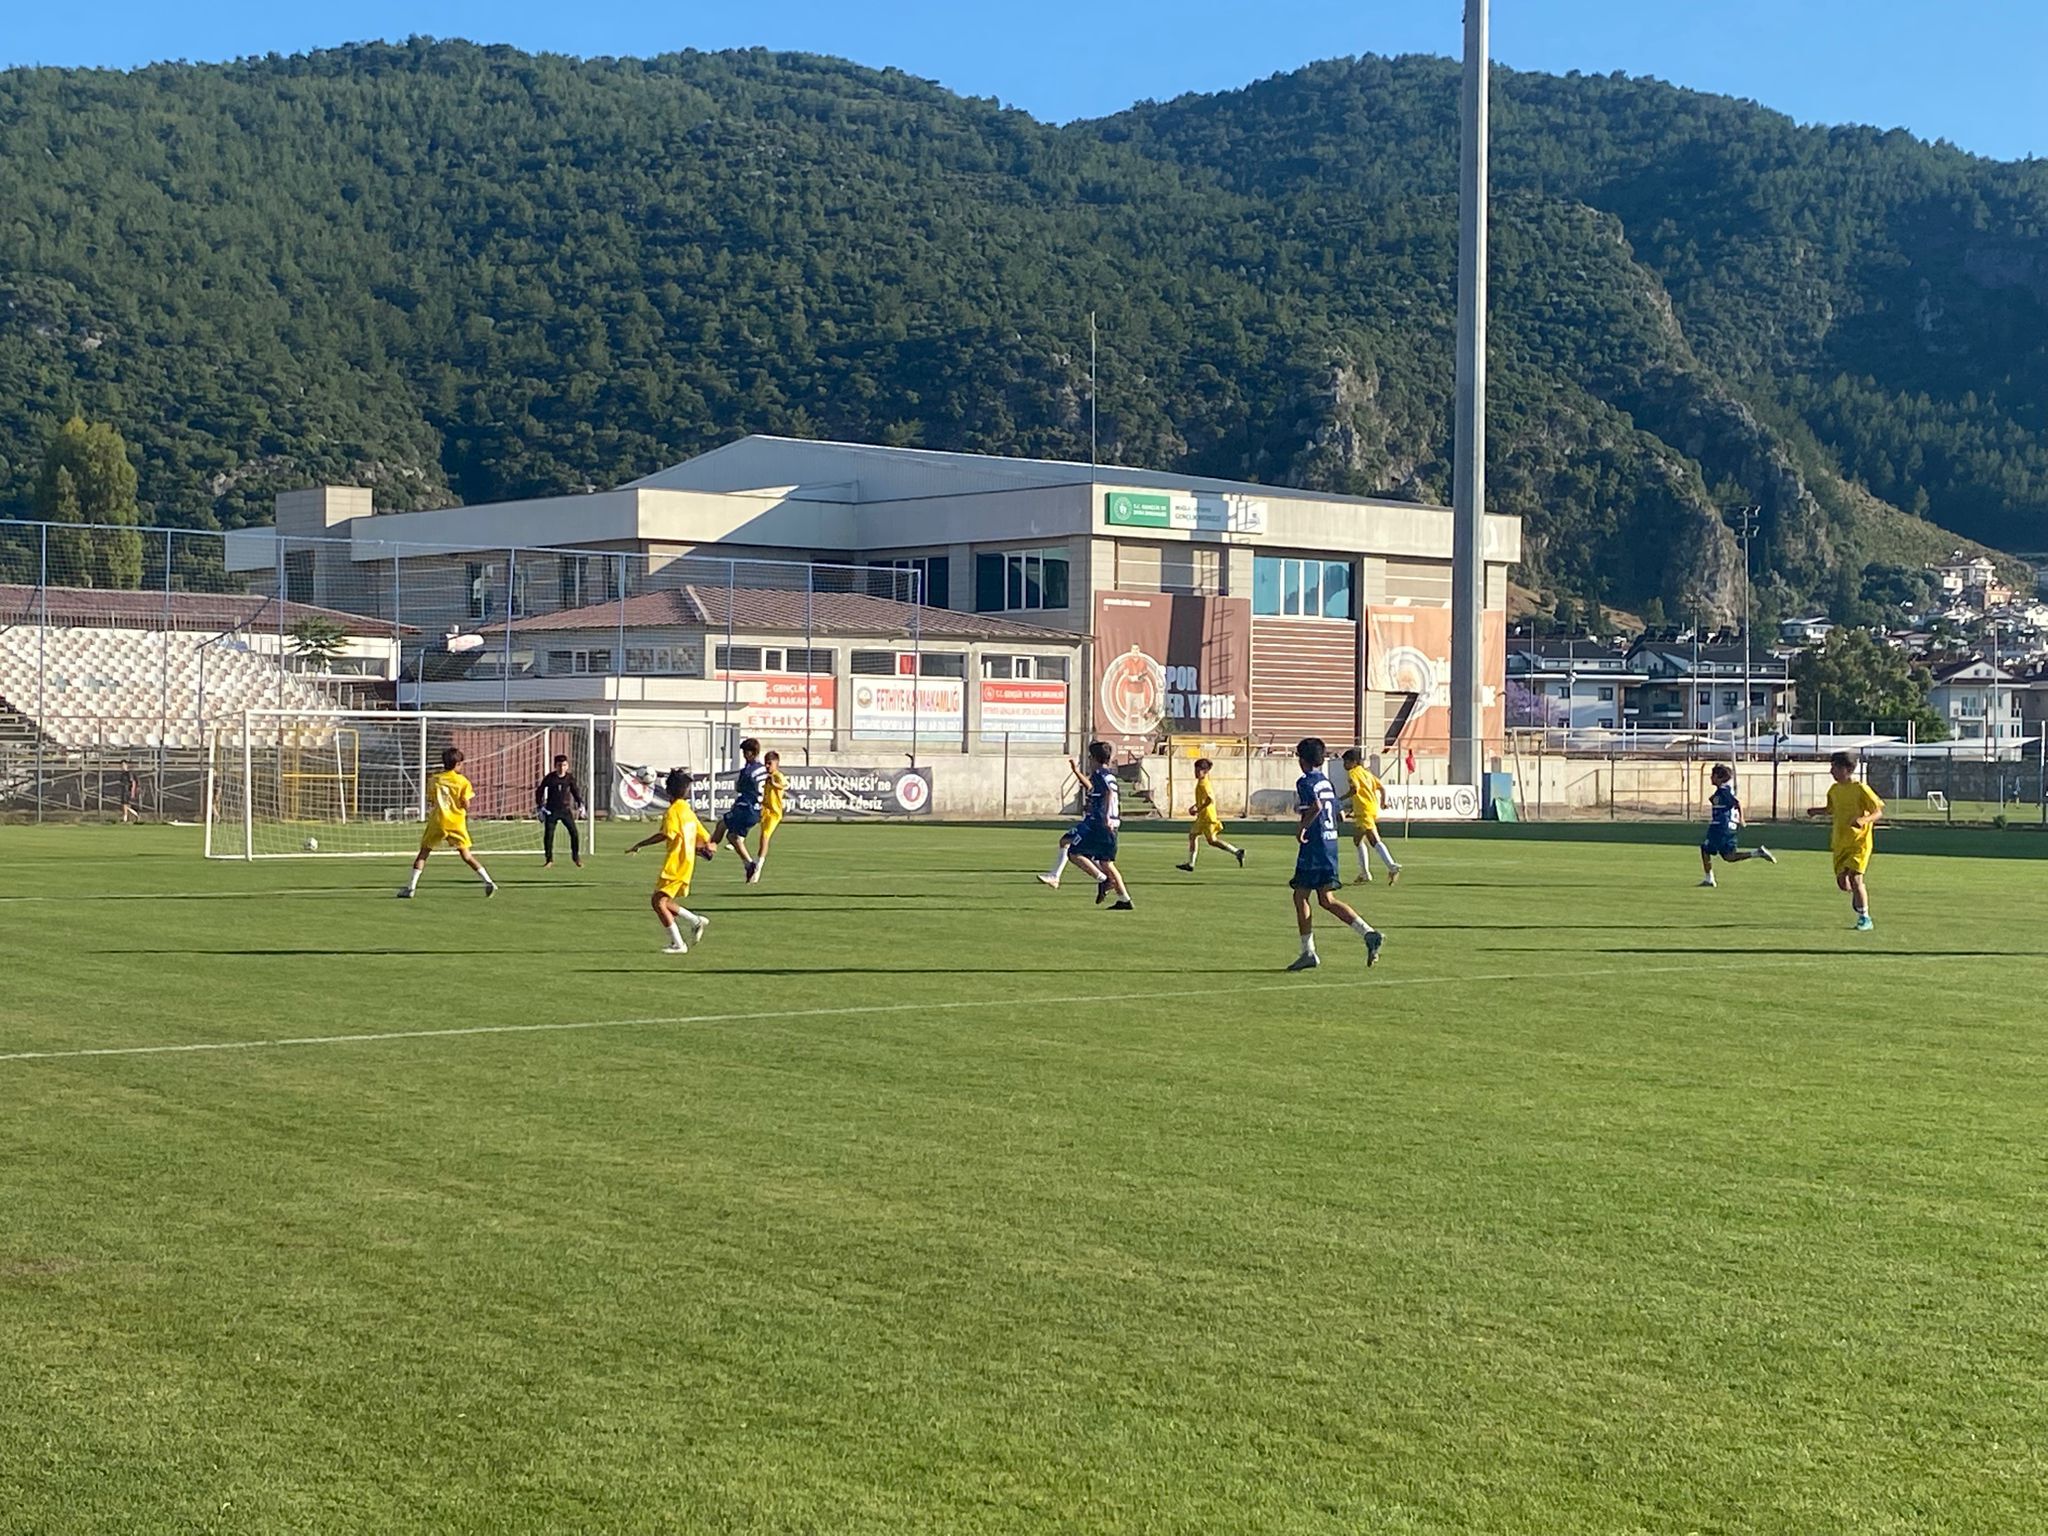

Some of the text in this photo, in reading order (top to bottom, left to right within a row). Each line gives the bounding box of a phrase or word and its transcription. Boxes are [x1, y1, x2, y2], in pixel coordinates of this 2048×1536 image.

[748, 714, 816, 726] ETHİYE
[783, 776, 813, 791] SNAF
[815, 773, 892, 791] HASTANESİ'ne
[1387, 796, 1452, 810] AVYERA PUB
[1324, 800, 1334, 830] 3
